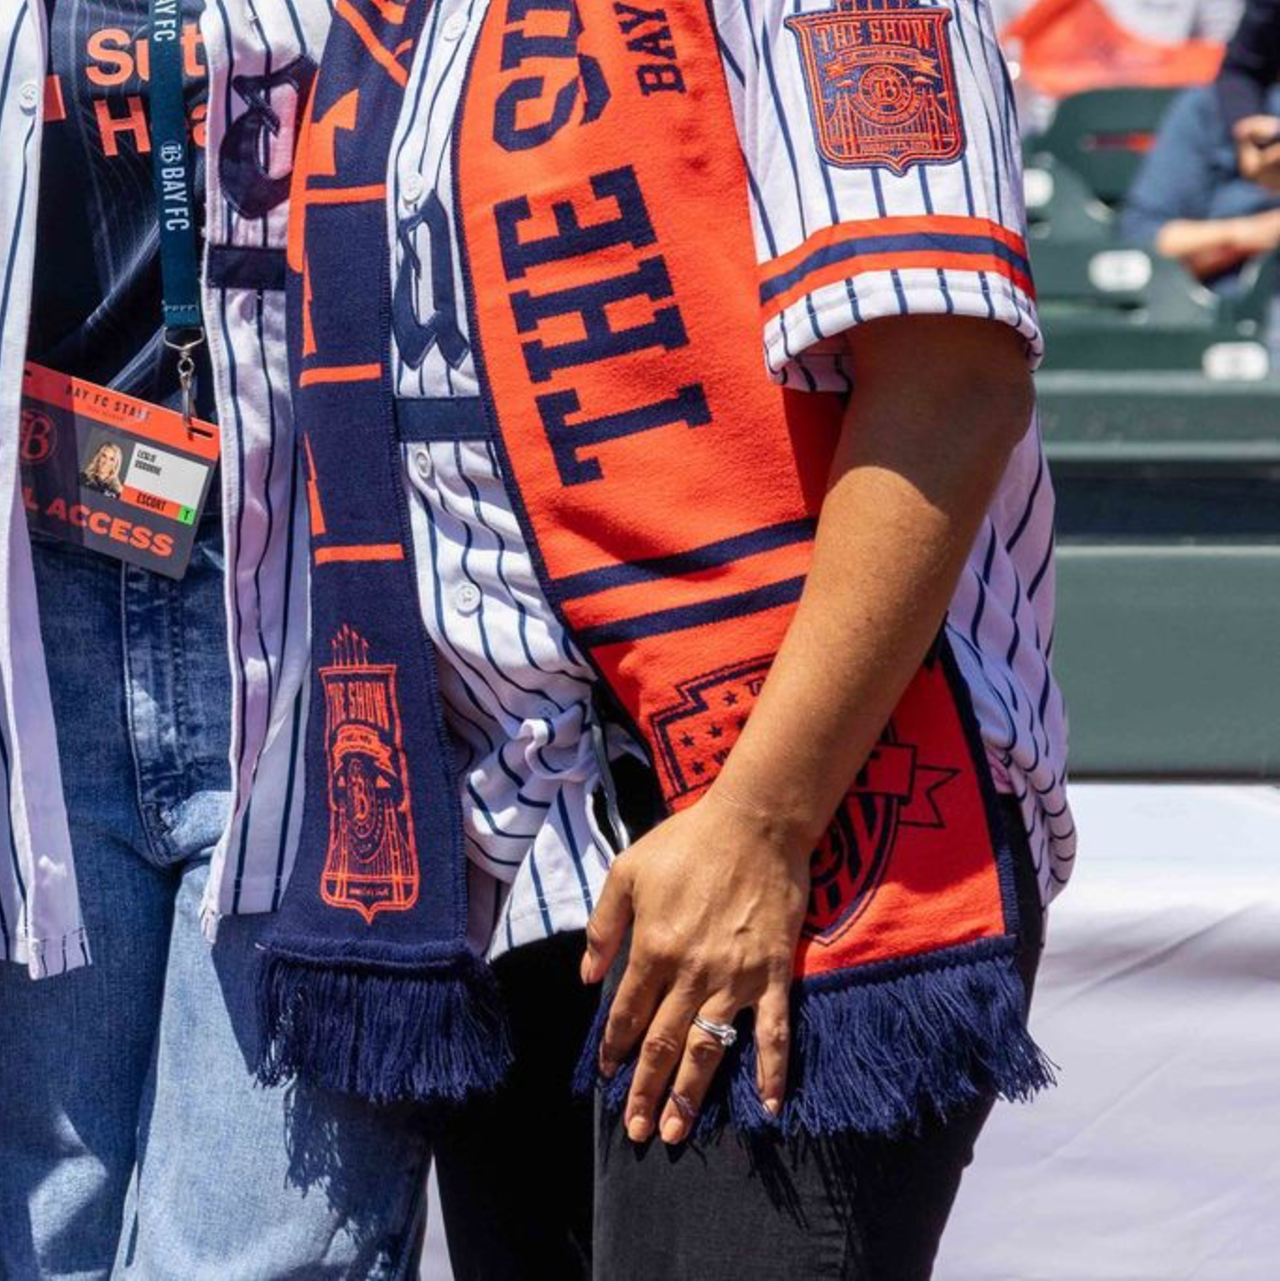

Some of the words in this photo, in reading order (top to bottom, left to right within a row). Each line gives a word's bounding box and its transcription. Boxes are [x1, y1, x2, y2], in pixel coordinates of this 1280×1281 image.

[154, 20, 176, 43] FC
[614, 1, 686, 96] BAY
[815, 22, 862, 53] THE
[867, 19, 932, 50] SHOW
[161, 167, 187, 203] BAY
[165, 208, 189, 231] FC
[492, 164, 713, 487] THE
[65, 384, 90, 400] BAY
[93, 395, 110, 407] FC
[114, 401, 152, 421] STAFF
[136, 489, 167, 511] ESCORT
[46, 497, 175, 557] ACCESS
